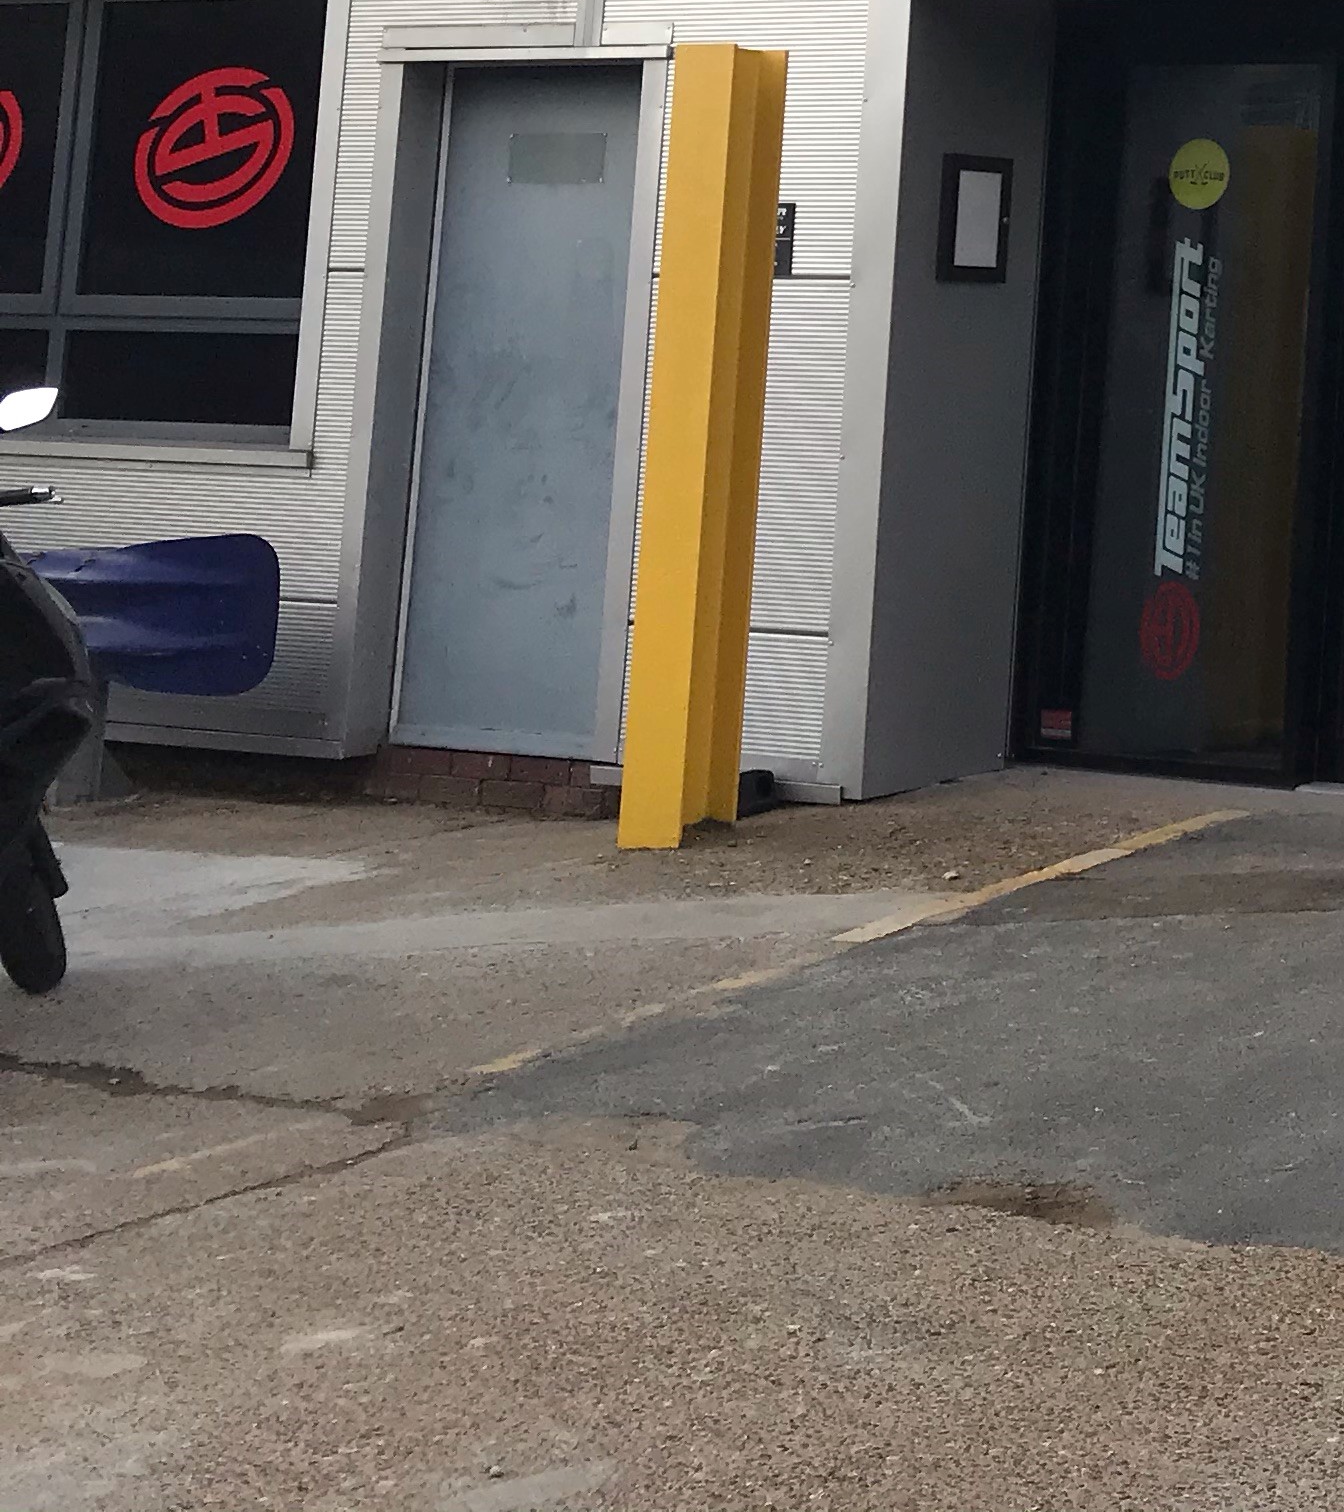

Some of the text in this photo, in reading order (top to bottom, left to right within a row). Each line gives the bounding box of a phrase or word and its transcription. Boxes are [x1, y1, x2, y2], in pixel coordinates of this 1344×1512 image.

[1173, 170, 1224, 181] PUTT CLUB
[1200, 255, 1224, 360] Karting
[1193, 379, 1213, 467] Indoor
[1189, 471, 1207, 516] UK
